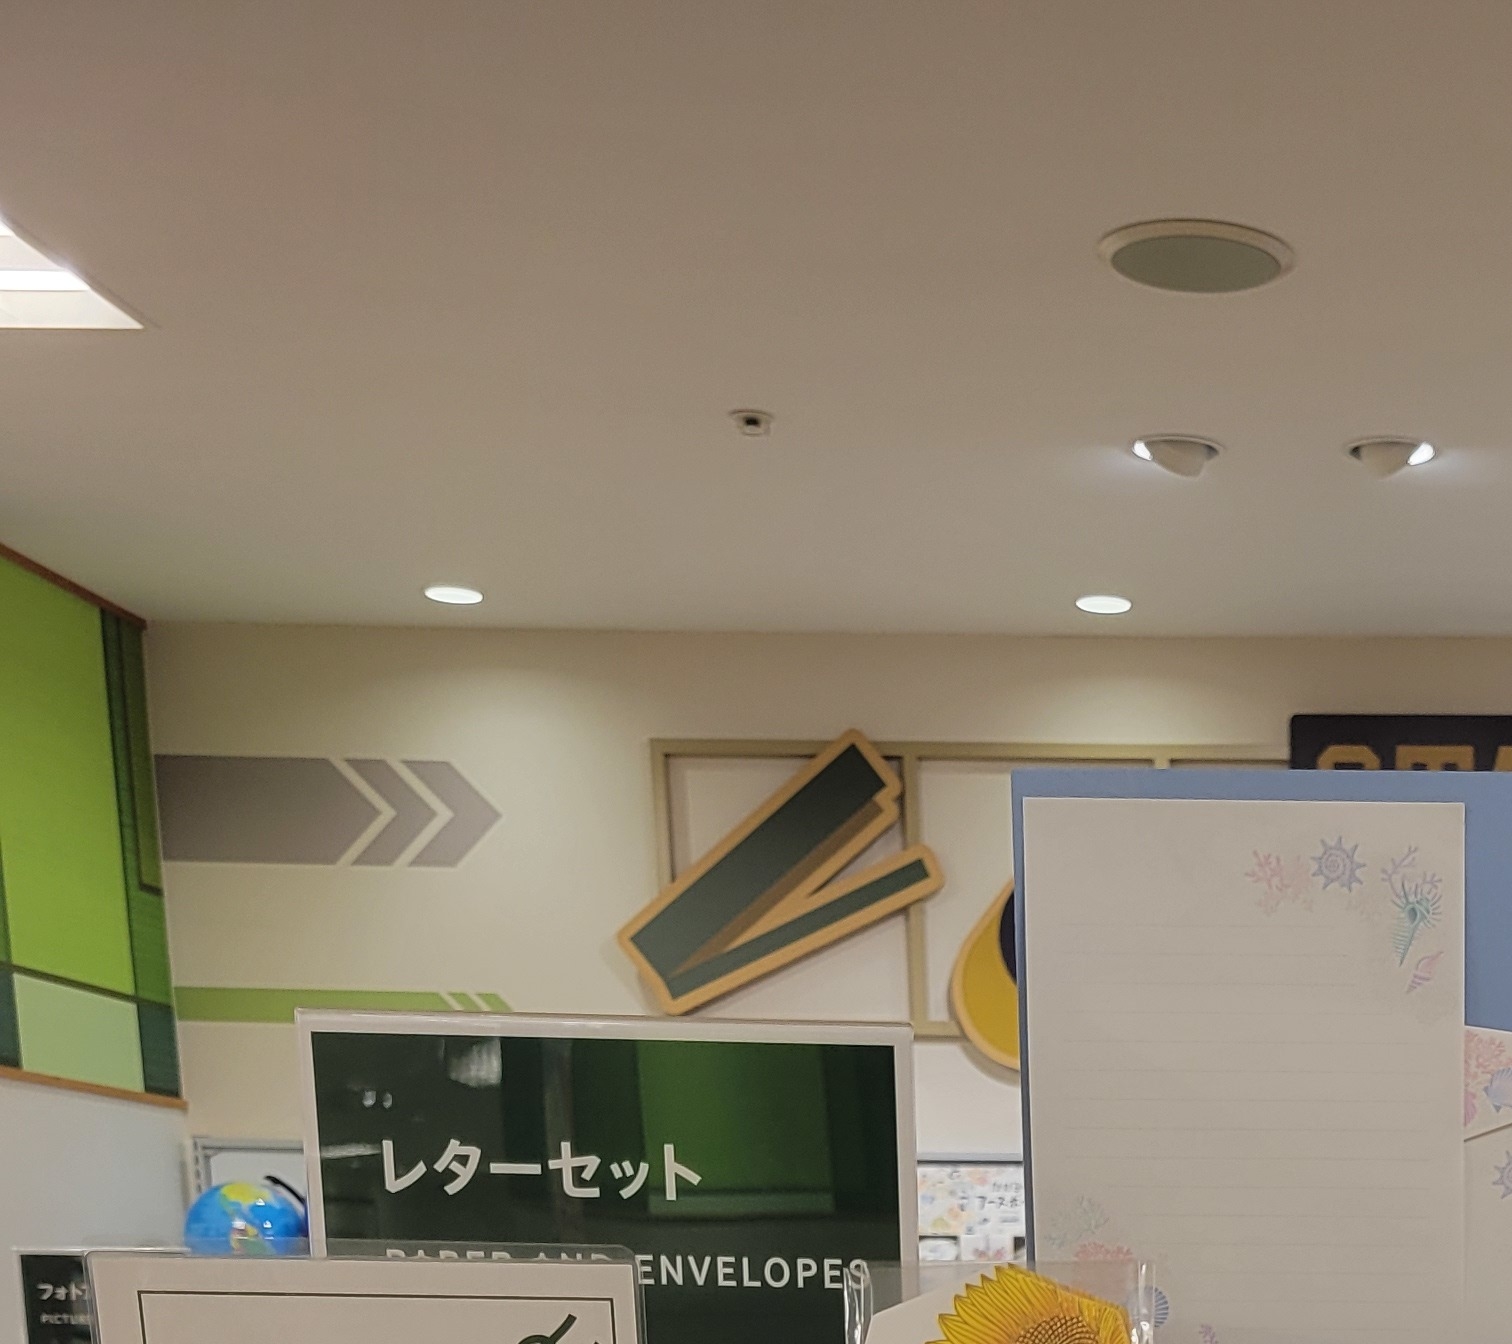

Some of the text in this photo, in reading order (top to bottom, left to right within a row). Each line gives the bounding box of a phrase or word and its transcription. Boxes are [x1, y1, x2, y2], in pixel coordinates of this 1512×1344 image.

[381, 1138, 702, 1201] レターセット
[636, 1253, 868, 1289] ENVELOPES
